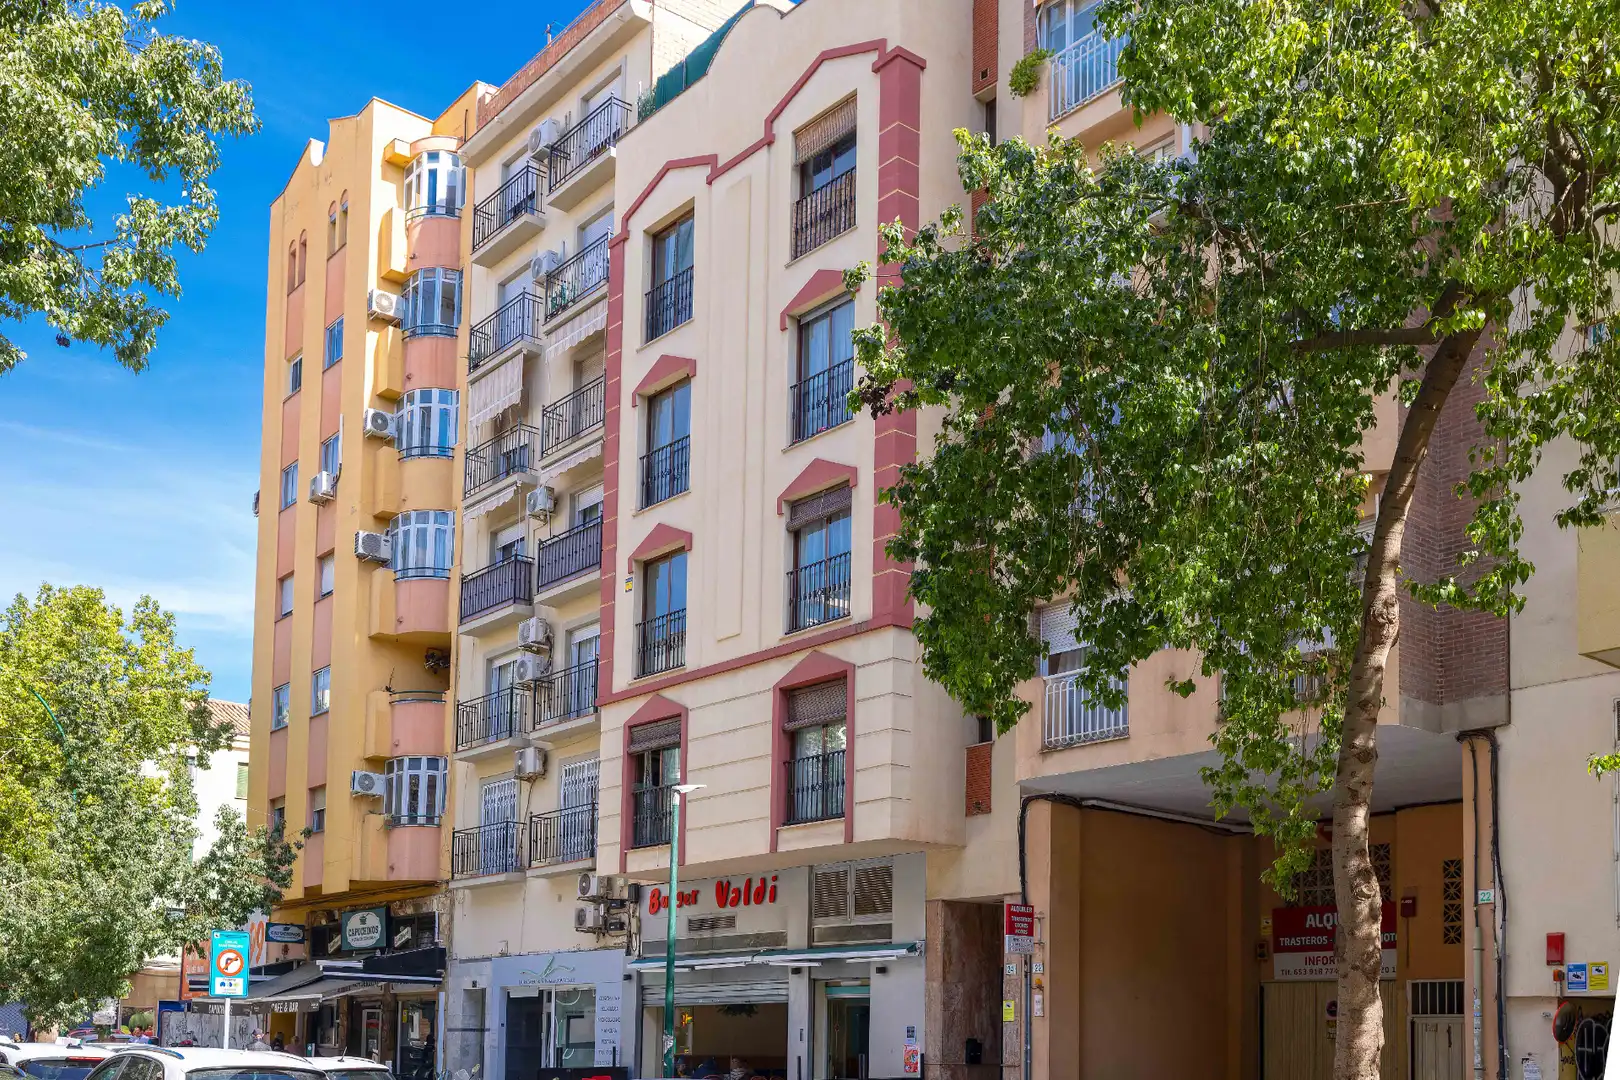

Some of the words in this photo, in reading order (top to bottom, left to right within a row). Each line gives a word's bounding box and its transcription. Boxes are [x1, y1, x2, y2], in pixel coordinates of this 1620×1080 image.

[649, 888, 699, 915] Buger
[715, 875, 777, 909] Valdi
[1480, 891, 1491, 902] 22
[1305, 912, 1340, 930] ALQU
[1279, 935, 1328, 946] TRASTEROS
[1304, 955, 1336, 966] INFOR
[1294, 968, 1307, 976] 653
